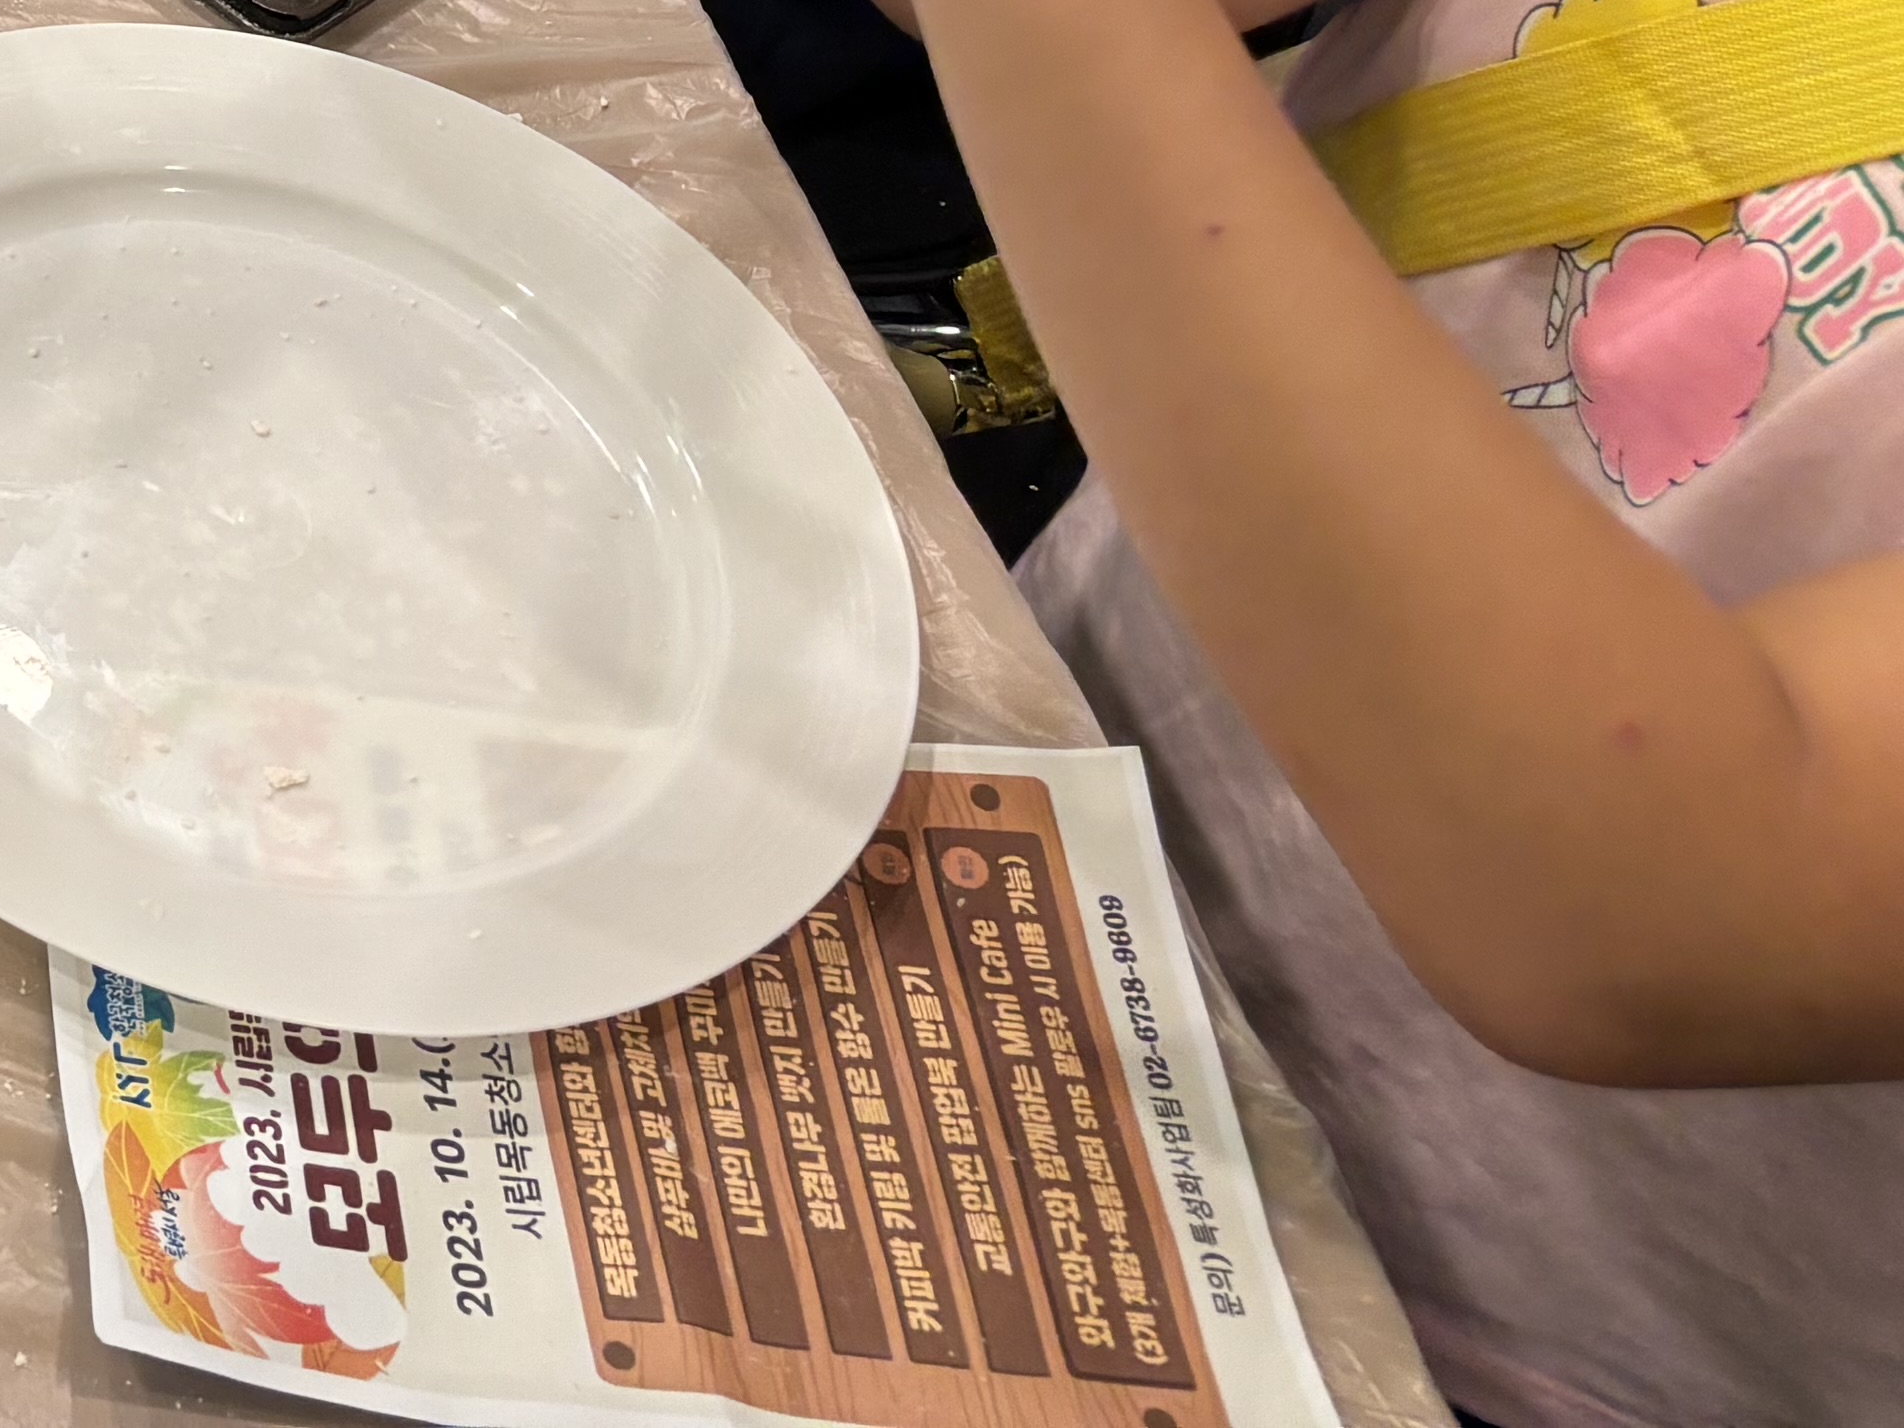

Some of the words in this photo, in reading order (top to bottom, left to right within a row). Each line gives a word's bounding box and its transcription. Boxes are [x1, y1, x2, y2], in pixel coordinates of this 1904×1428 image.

[997, 853, 1038, 915] 가능)
[804, 911, 856, 995] 만들기
[967, 918, 1014, 986] Cafe
[1018, 922, 1052, 970] 이용
[1037, 975, 1062, 1000] 시
[749, 952, 799, 1039] 만들기
[831, 1002, 874, 1060] 향수
[898, 964, 953, 1050] 만들기
[982, 993, 1035, 1057] Mini
[1097, 894, 1173, 1090] 02-6738-9609
[1042, 1005, 1087, 1079] 팔로우
[639, 1110, 672, 1141] 및
[695, 1051, 747, 1140] 에코백
[922, 1056, 979, 1146] 팝업북
[1009, 1063, 1073, 1181] 함께하는
[1068, 1084, 1100, 1129] sns
[243, 1109, 293, 1215] 2023.
[430, 1127, 469, 1183] 10.
[559, 1061, 639, 1298] 목동청소년센터와
[786, 1111, 846, 1230] 환경나무
[861, 1133, 896, 1163] 및
[1152, 1097, 1221, 1247] 특성화사업팀
[717, 1146, 768, 1237] 나만의
[870, 1171, 917, 1230] 키링
[947, 1152, 1014, 1276] 교통안전
[1075, 1134, 1150, 1307] 체험+목동센터
[442, 1199, 494, 1317] 2023.
[890, 1237, 943, 1332] 커피박
[1040, 1187, 1116, 1349] 와구와구와
[1198, 1251, 1246, 1318] 문의)
[1123, 1310, 1170, 1367] (3개
